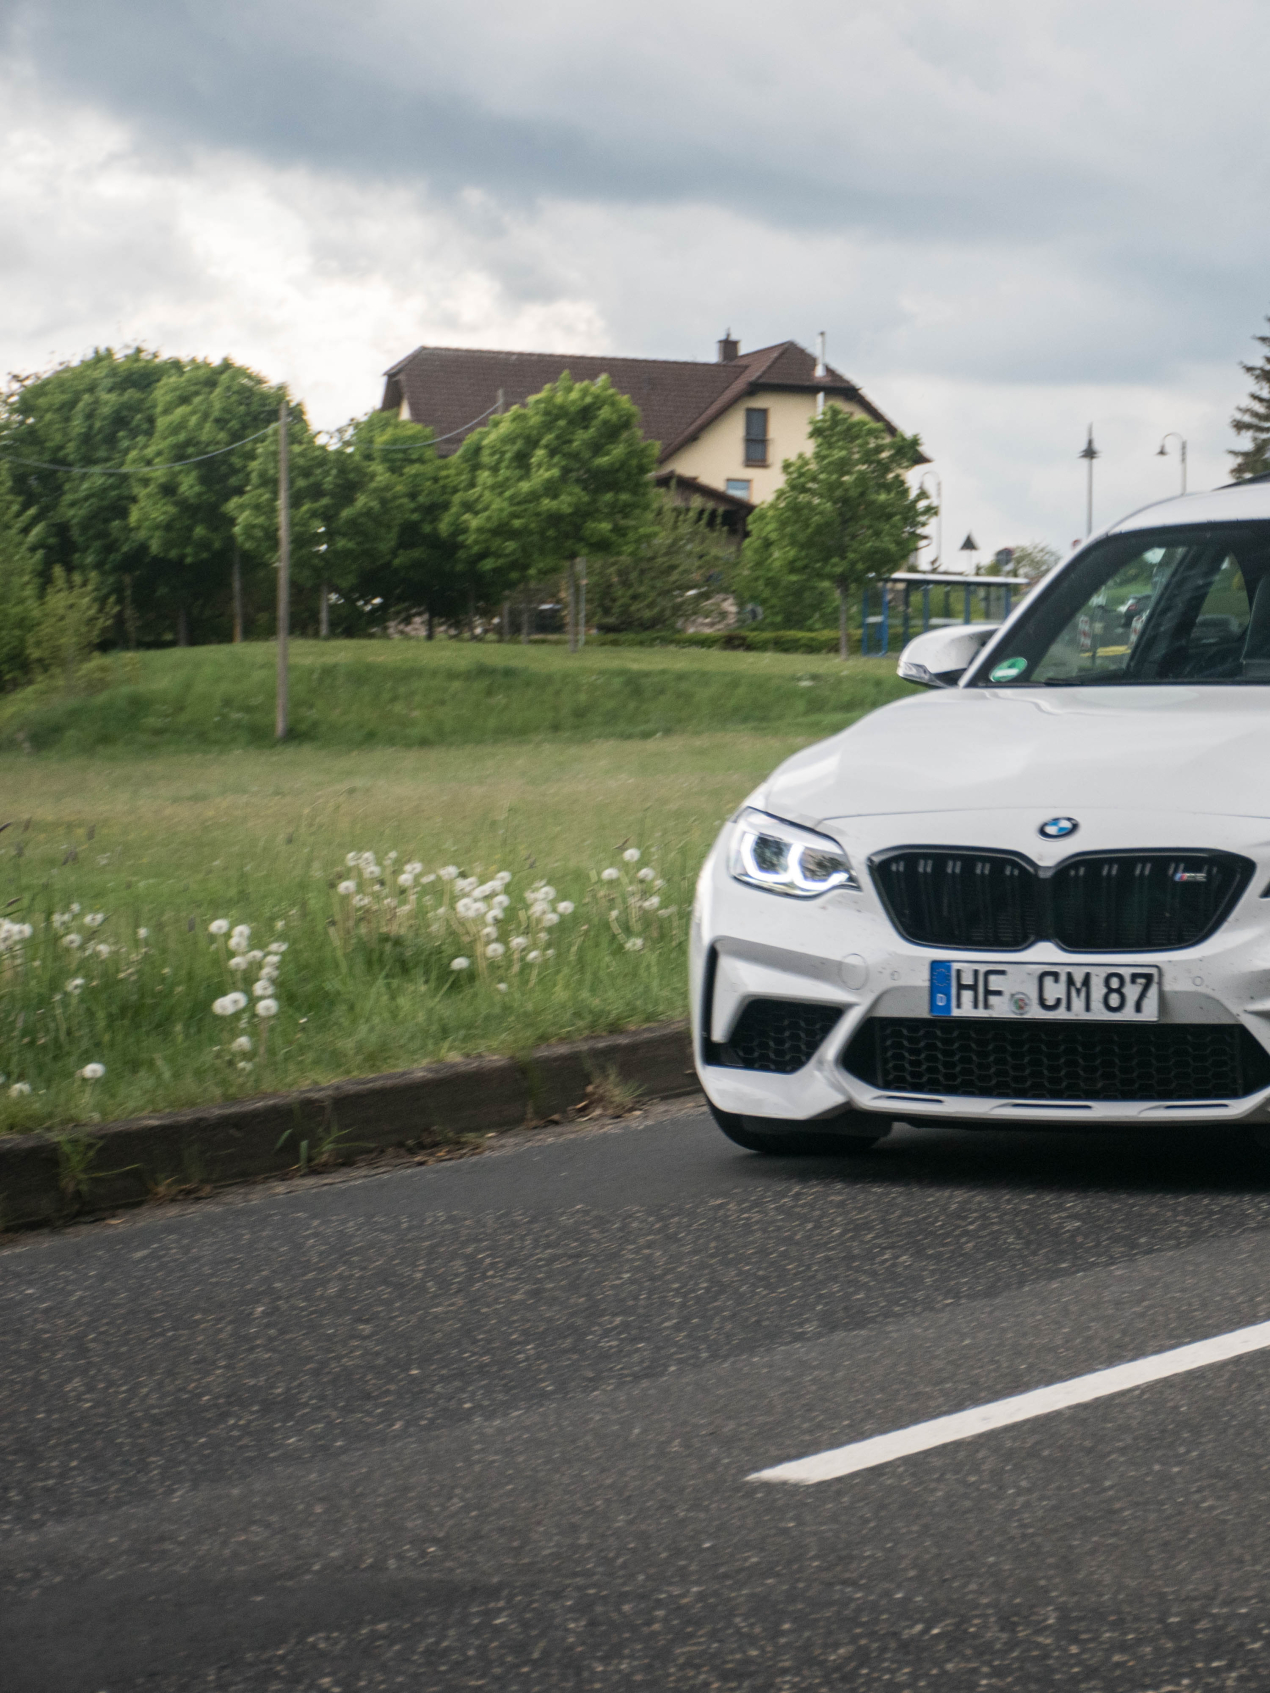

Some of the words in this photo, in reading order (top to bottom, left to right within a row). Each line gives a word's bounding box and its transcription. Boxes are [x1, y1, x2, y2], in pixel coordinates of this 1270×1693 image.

[936, 993, 947, 1006] D
[955, 968, 1007, 1010] HF
[1038, 970, 1091, 1013] CM
[1103, 972, 1154, 1014] 87
